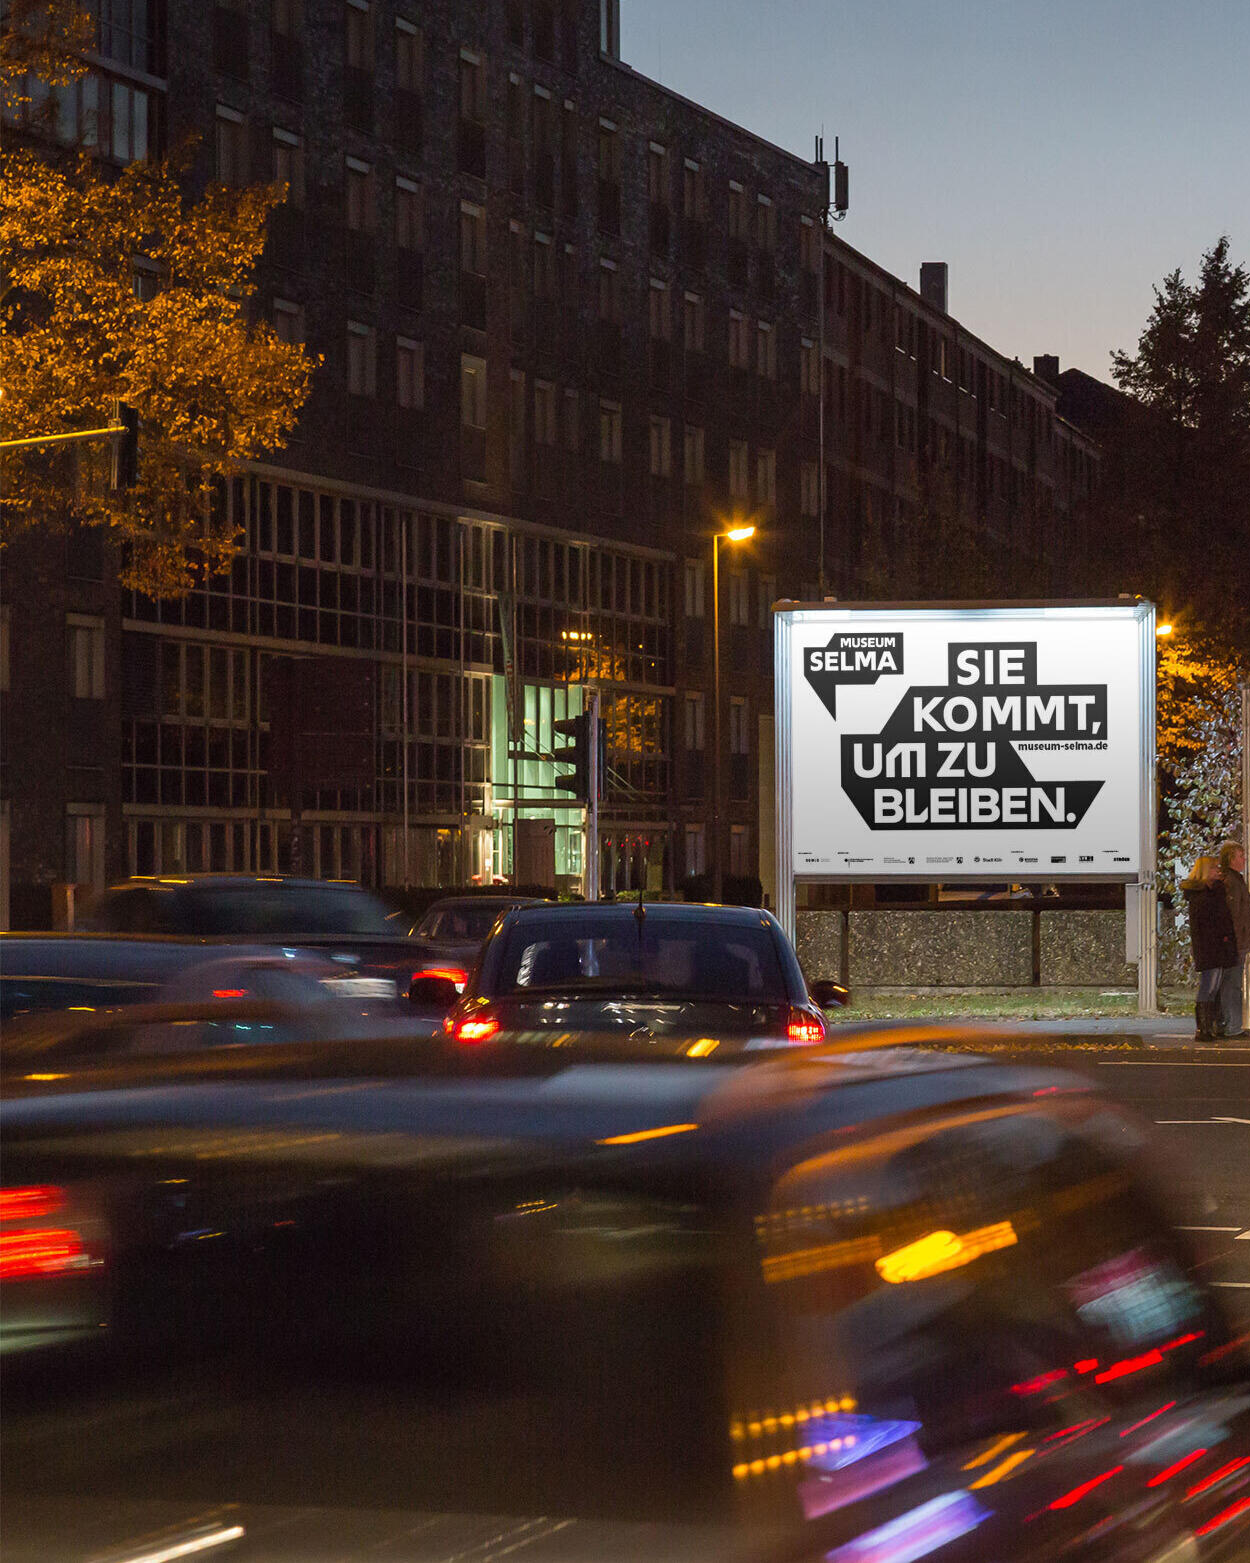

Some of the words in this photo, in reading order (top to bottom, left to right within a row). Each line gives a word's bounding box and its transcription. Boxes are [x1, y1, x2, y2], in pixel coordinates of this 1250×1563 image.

[809, 650, 898, 672] SELMA
[840, 636, 896, 649] MUSEUM
[956, 649, 1026, 686] SIE
[913, 694, 1102, 735] KOMMT,
[936, 741, 996, 778] ZU
[1017, 741, 1108, 752] museum-selma.de
[874, 787, 1077, 824] BLEIBEN.
